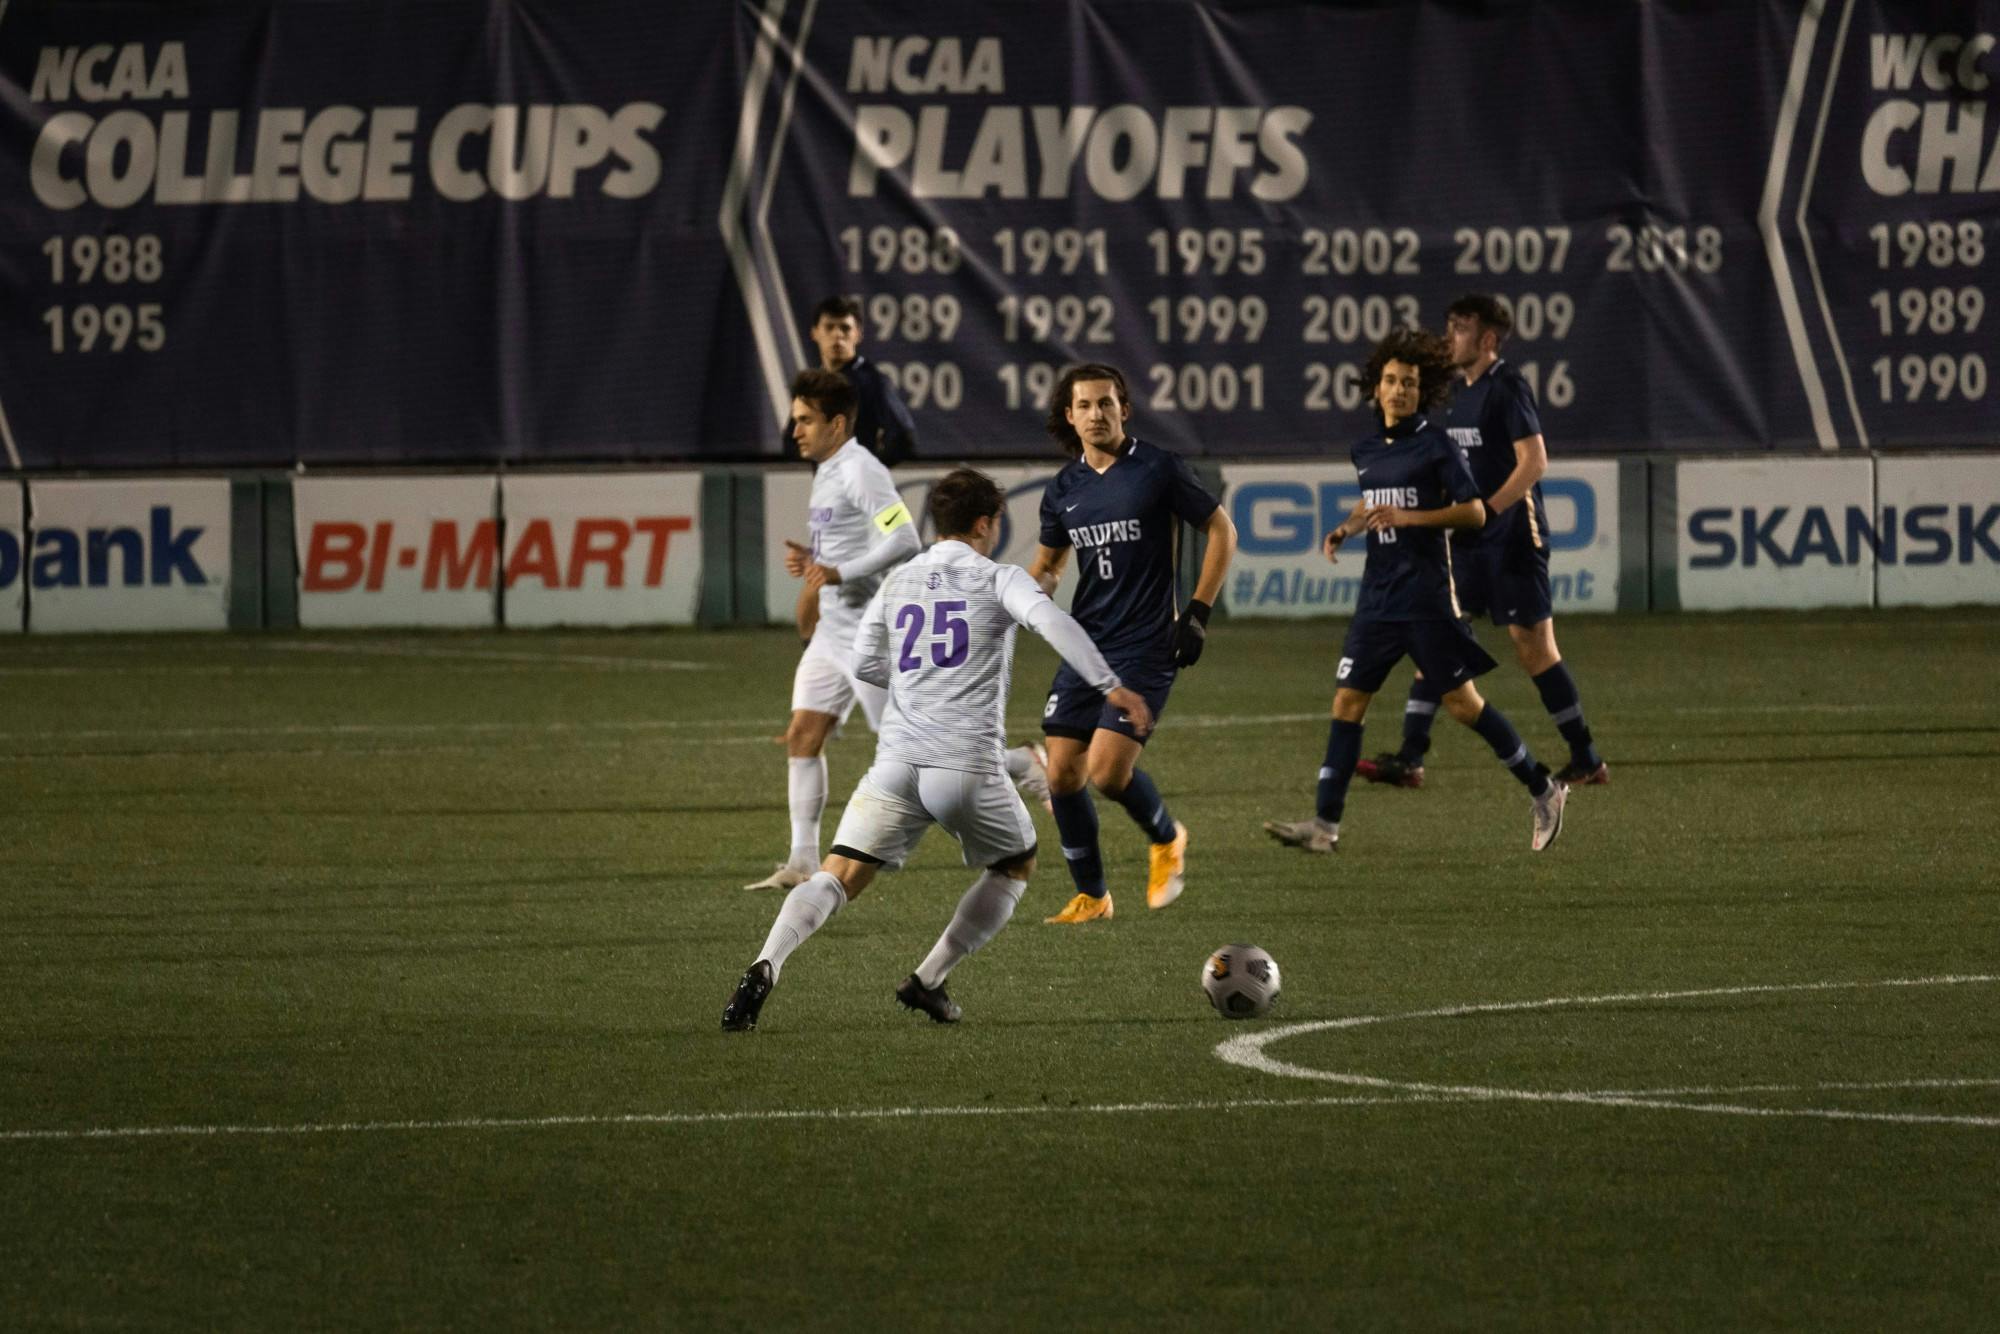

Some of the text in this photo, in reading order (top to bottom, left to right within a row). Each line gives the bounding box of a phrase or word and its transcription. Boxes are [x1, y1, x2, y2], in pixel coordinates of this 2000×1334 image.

[31, 41, 189, 103] NCAA
[846, 36, 1005, 95] NCAA
[1870, 33, 1995, 91] WCC
[30, 100, 668, 209] COLLEGE CUPS
[847, 104, 1314, 202] PLAYOFFS
[43, 234, 163, 285] 1988
[841, 225, 1723, 276] 1988 1991 1995 2002 2007 2018
[1869, 220, 1985, 269] 1988
[43, 304, 167, 353] 1995
[997, 296, 1115, 343] 1992
[1148, 296, 1268, 344] 1999
[1495, 291, 1575, 341] 09
[1869, 286, 1985, 336] 1989
[876, 360, 1575, 411] 90 19 2001 20 16
[1871, 354, 1987, 403] 1990
[1068, 519, 1142, 549] BRUINS
[1688, 504, 2000, 569] SKANSK
[1097, 546, 1114, 580] 6
[895, 601, 969, 673] 25
